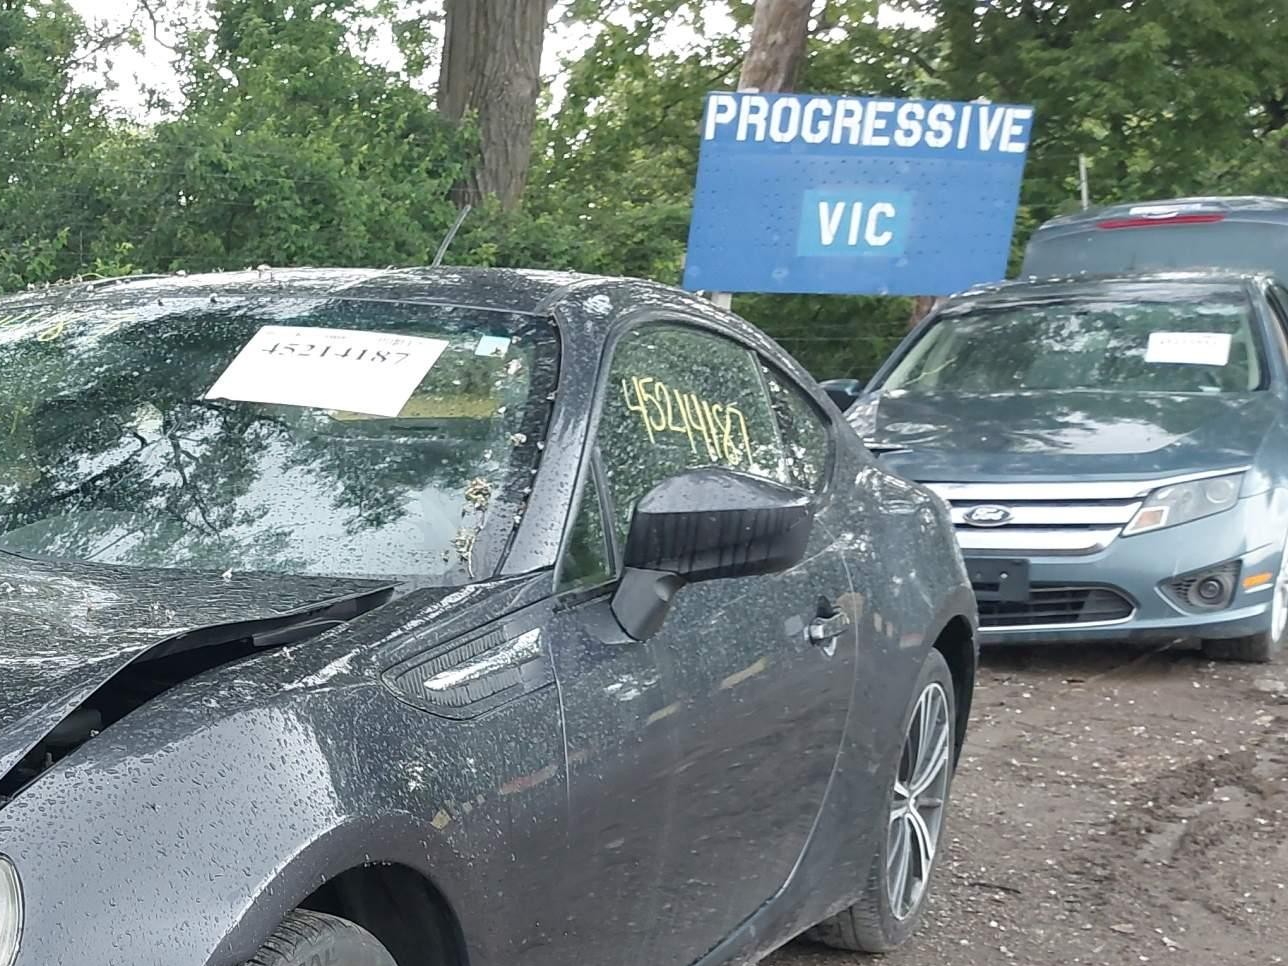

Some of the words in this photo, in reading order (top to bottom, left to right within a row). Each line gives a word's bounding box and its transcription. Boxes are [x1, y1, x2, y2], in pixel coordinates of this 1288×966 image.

[704, 95, 1034, 153] PROGRESSIVE
[818, 201, 896, 247] VIC
[261, 342, 411, 365] 45214187
[621, 376, 753, 465] 45214187
